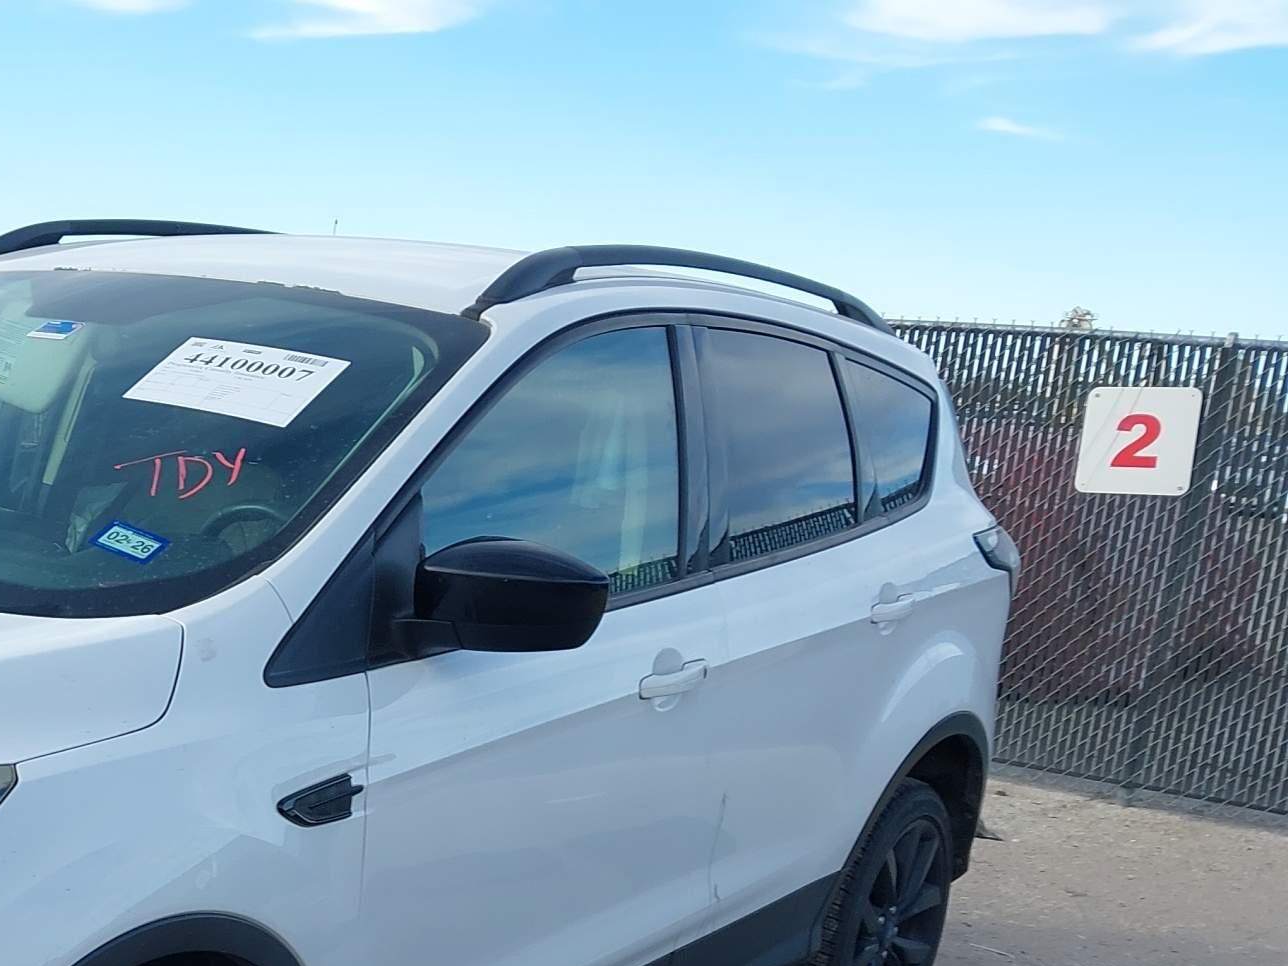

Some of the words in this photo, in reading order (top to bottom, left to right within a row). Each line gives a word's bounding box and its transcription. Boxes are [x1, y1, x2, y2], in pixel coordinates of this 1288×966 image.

[184, 352, 316, 382] 44100007
[1110, 413, 1162, 469] 2
[113, 447, 247, 499] TDY
